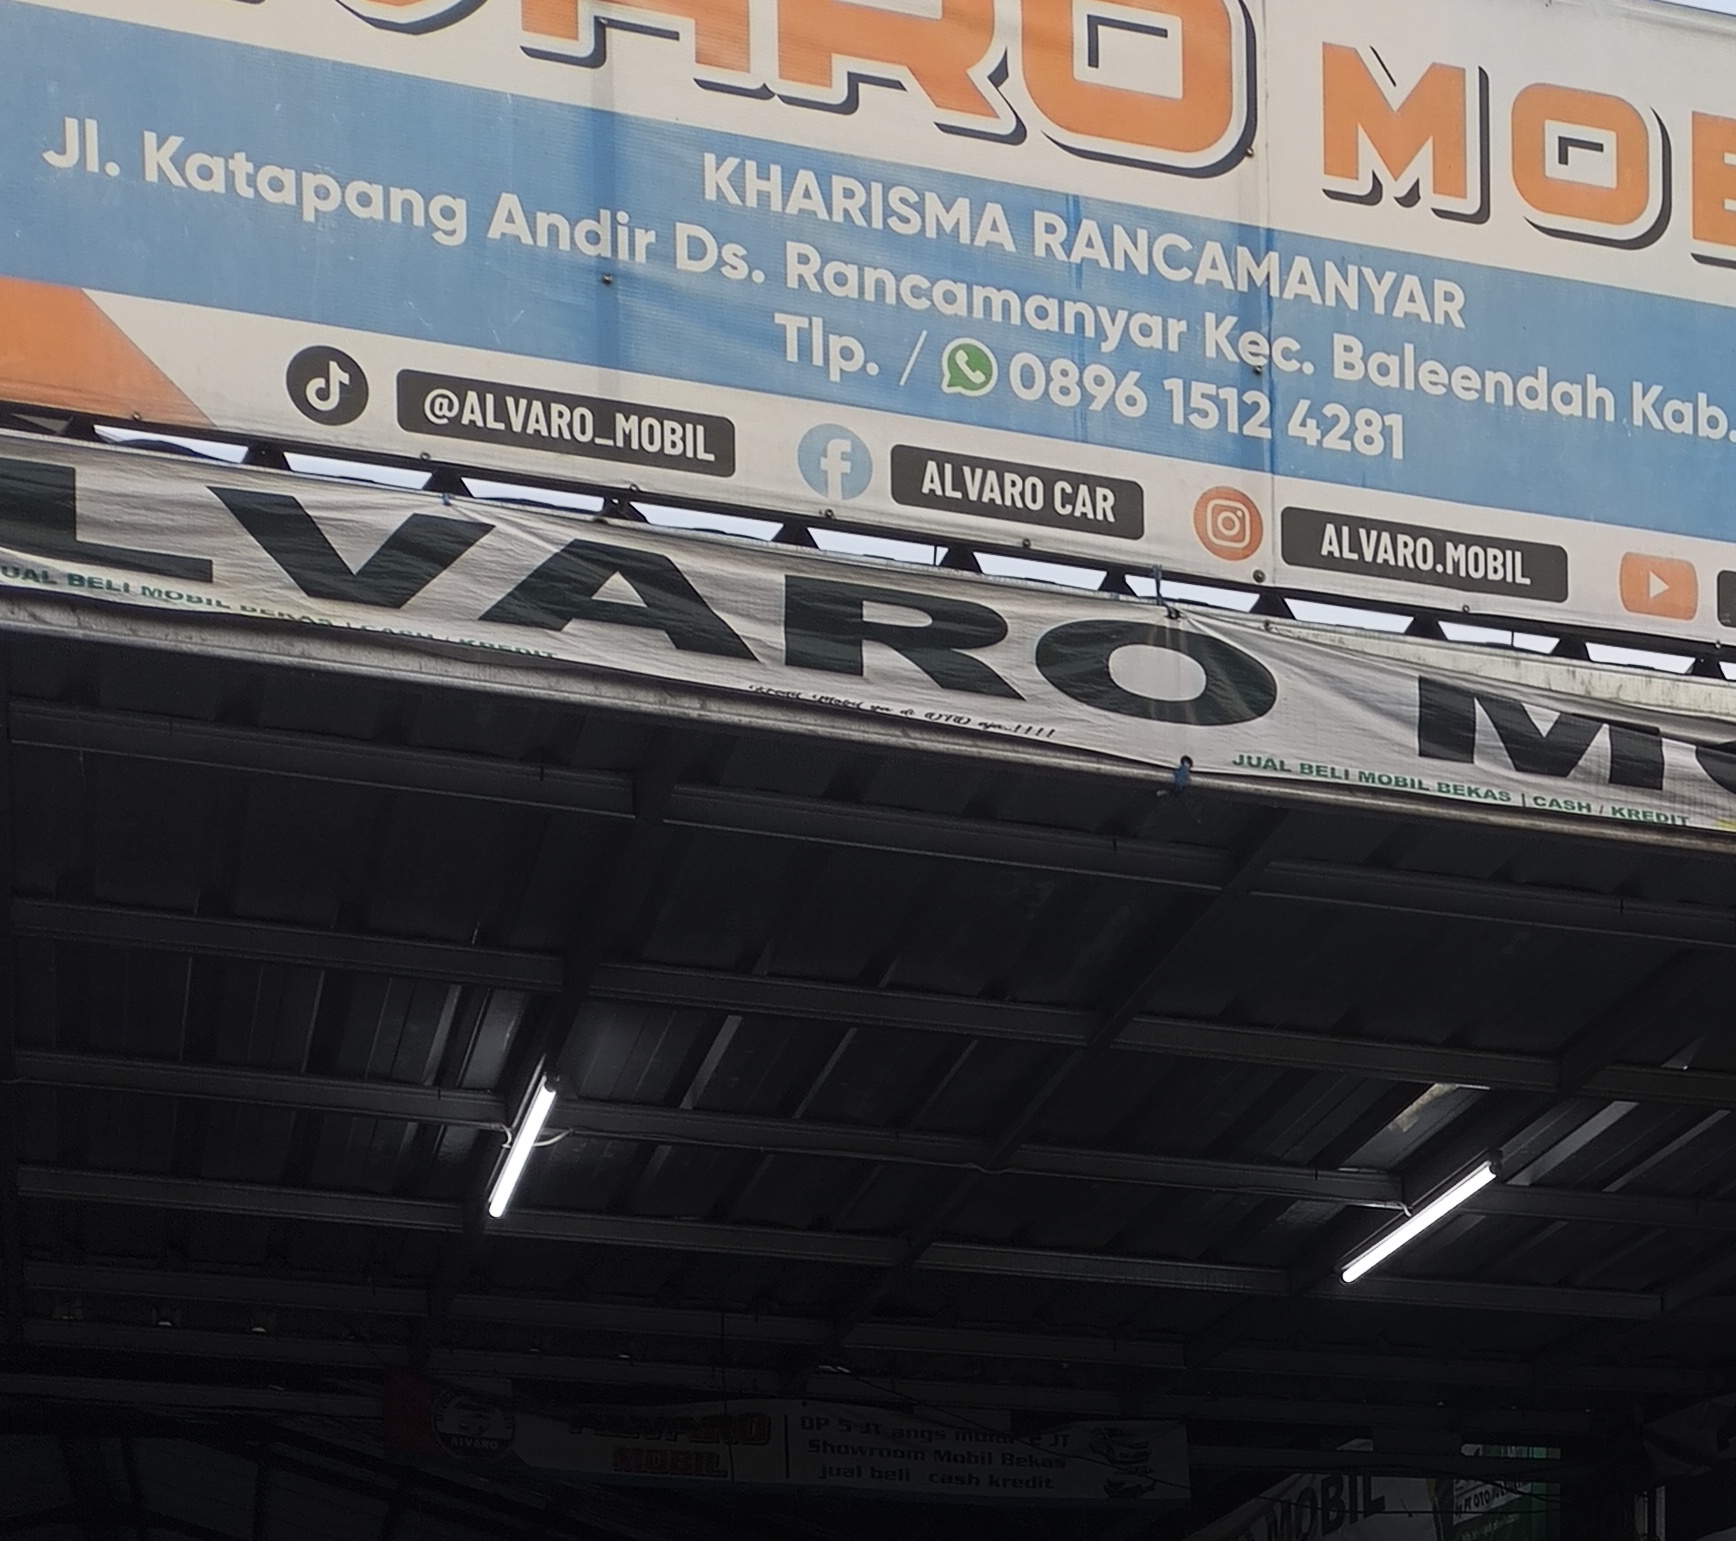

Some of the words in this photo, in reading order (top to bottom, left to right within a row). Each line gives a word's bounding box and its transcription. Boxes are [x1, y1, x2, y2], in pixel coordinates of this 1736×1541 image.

[42, 117, 121, 177] Jl.
[142, 130, 468, 247] Katapang
[487, 193, 656, 266] Andir
[673, 223, 766, 286] Ds.
[784, 240, 1187, 354] Rancamanyar
[1204, 316, 1315, 376] Kec.
[1333, 335, 1614, 425] Baleendah
[703, 153, 1015, 252] KHARISMA
[1032, 202, 1465, 328] RANCAMANYAR
[773, 312, 880, 382] Tlp.
[898, 330, 929, 387] /
[1009, 353, 1148, 418] 0896
[1164, 379, 1271, 439] 1512
[1287, 403, 1405, 461] 4281
[422, 387, 717, 462] @ALVARO_MOBIL
[921, 459, 1045, 511] ALVARO
[1053, 478, 1117, 523] CAR
[1320, 522, 1532, 587] ALVARO.MOBIL
[0, 457, 1277, 726] LVARO
[67, 573, 131, 596] BELI
[140, 585, 231, 610] MOBIL
[1233, 754, 1292, 774] JUAL
[1300, 763, 1350, 781] BELI
[1358, 771, 1430, 792] MOBIL
[1437, 781, 1511, 803] BEKAS
[1533, 795, 1592, 815] CASH
[1611, 805, 1689, 827] KREDIT
[613, 1446, 728, 1477] MOBIL
[801, 1415, 829, 1432] DP
[1049, 1434, 1070, 1449] JT
[807, 1439, 926, 1461] Showroom
[934, 1448, 993, 1466] Mobil
[1002, 1452, 1067, 1470] Bekas
[819, 1461, 862, 1479] jual
[871, 1465, 911, 1481] beli
[929, 1471, 981, 1487] cash
[988, 1474, 1054, 1490] kredit
